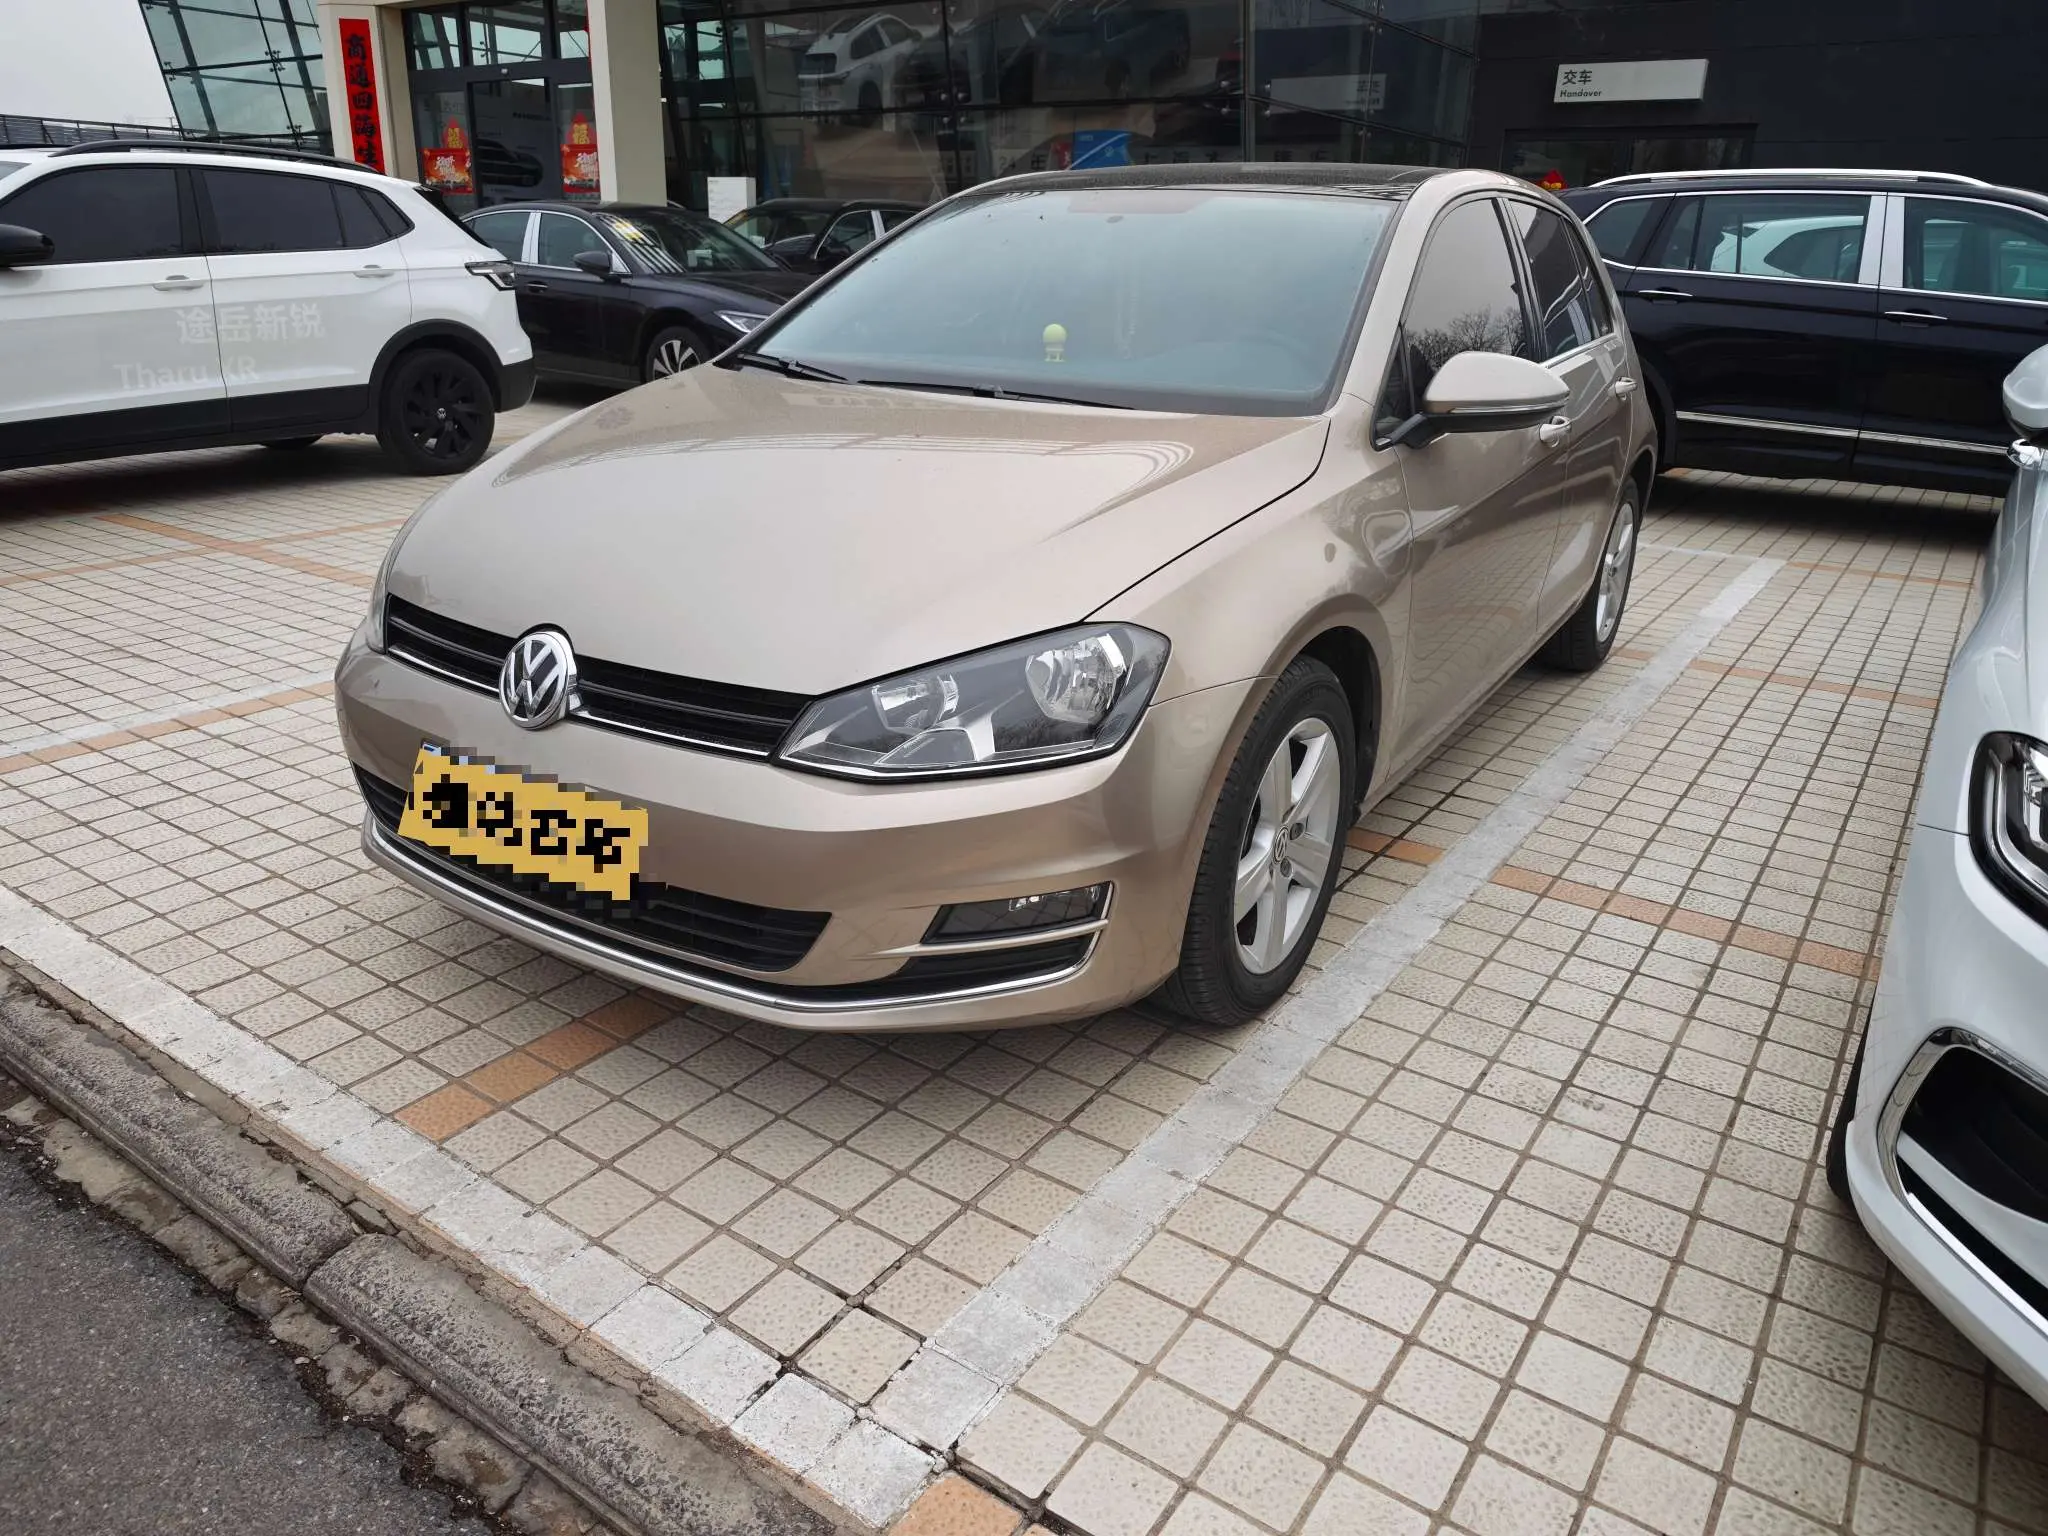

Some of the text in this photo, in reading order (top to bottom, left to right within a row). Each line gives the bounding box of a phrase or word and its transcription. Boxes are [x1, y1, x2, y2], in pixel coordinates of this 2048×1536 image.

[1561, 69, 1593, 86] 交车
[1559, 88, 1602, 98] Handover
[175, 302, 326, 345] 途岳新锐
[112, 362, 209, 390] Tharu
[500, 632, 569, 730] VW
